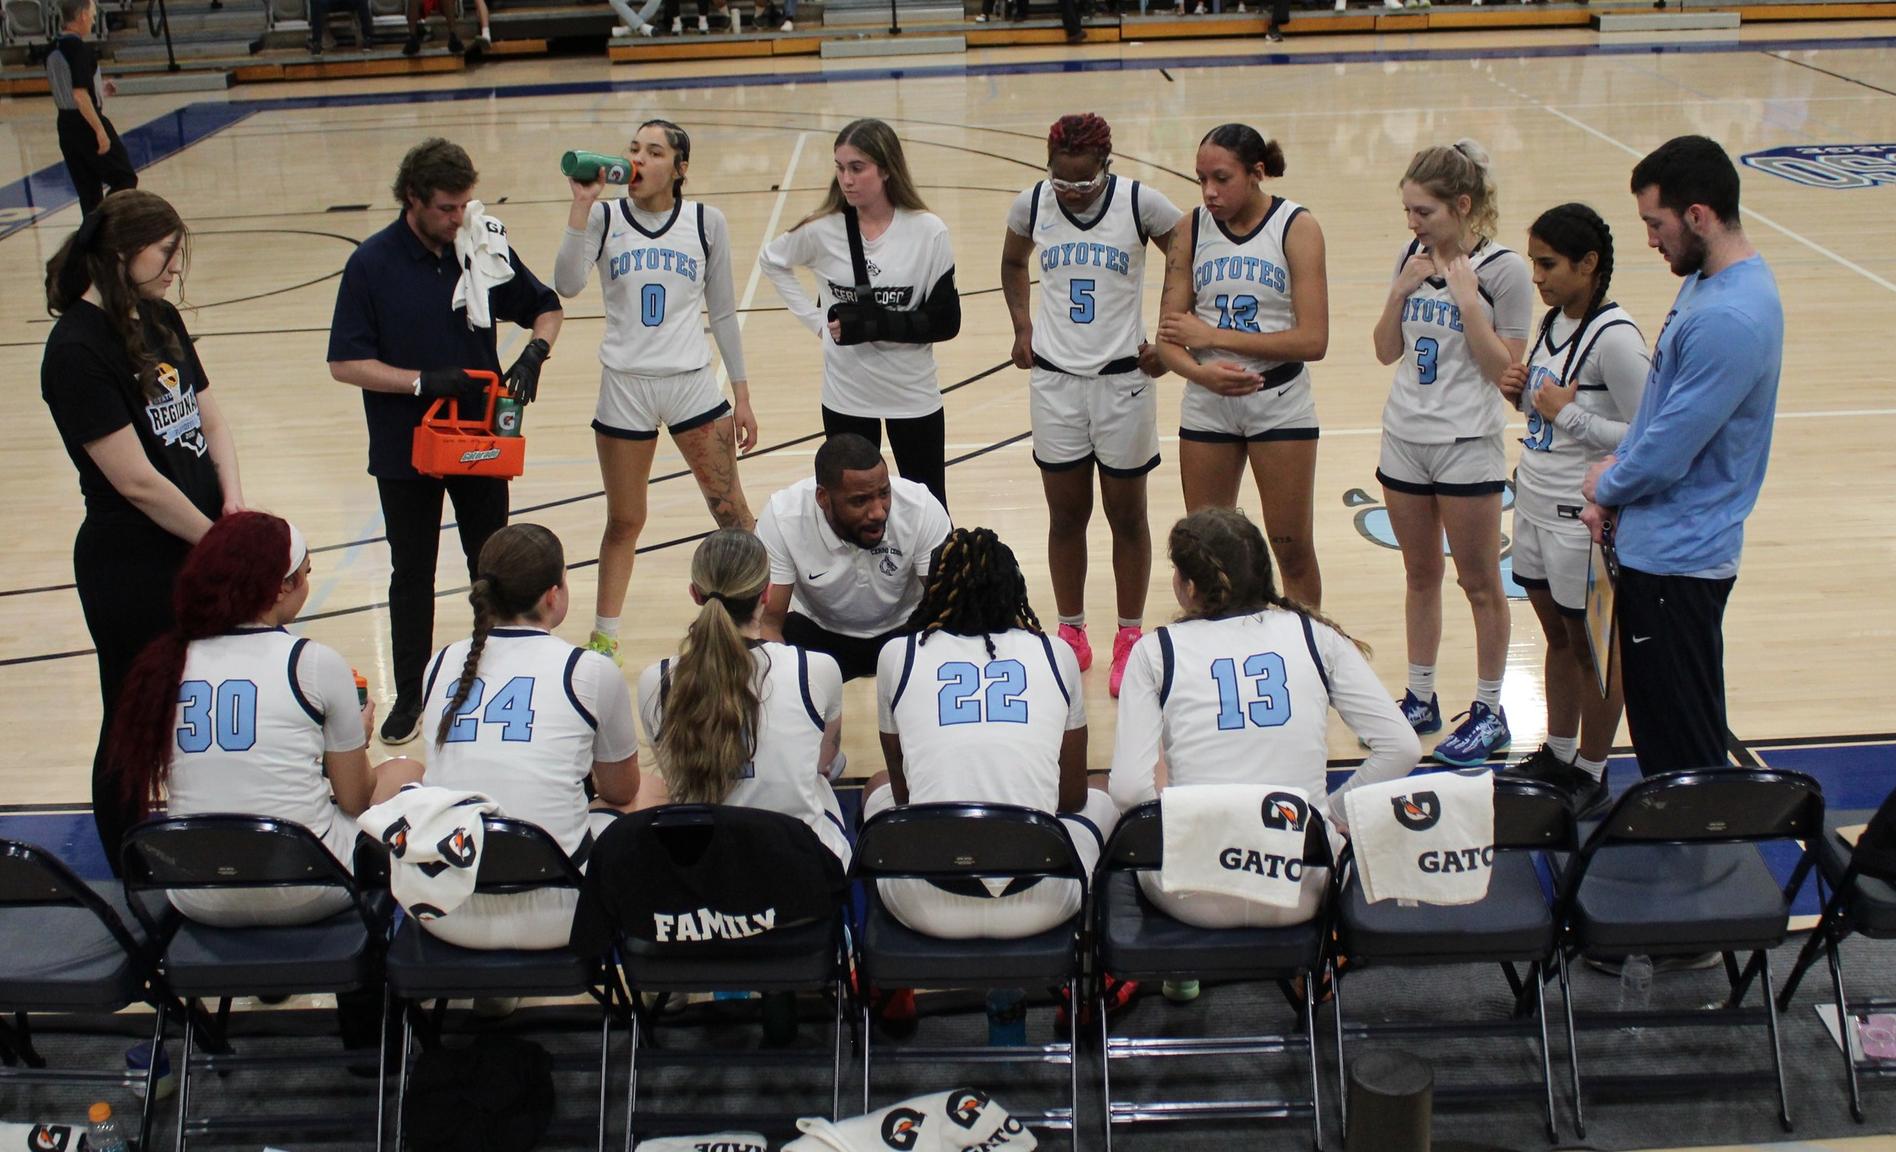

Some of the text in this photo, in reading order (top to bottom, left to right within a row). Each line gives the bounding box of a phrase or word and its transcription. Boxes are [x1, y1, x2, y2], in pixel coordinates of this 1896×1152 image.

[610, 247, 697, 282] COYOTES
[1040, 242, 1130, 276] COYOTES
[1196, 255, 1287, 294] COYOTES
[641, 283, 666, 327] 0
[1069, 278, 1096, 324] 5
[1215, 294, 1261, 333] 12
[1402, 297, 1464, 333] OYOTE
[1414, 336, 1440, 385] 3
[149, 392, 197, 430] REGIONA
[499, 411, 516, 430] G
[442, 676, 536, 743] 24
[937, 658, 1029, 726] 22
[1210, 651, 1293, 730] 13
[176, 679, 258, 753] 30
[1219, 847, 1303, 882] GATO
[1418, 845, 1494, 873] GATO
[653, 907, 776, 942] FAMILY
[881, 1107, 927, 1152] G
